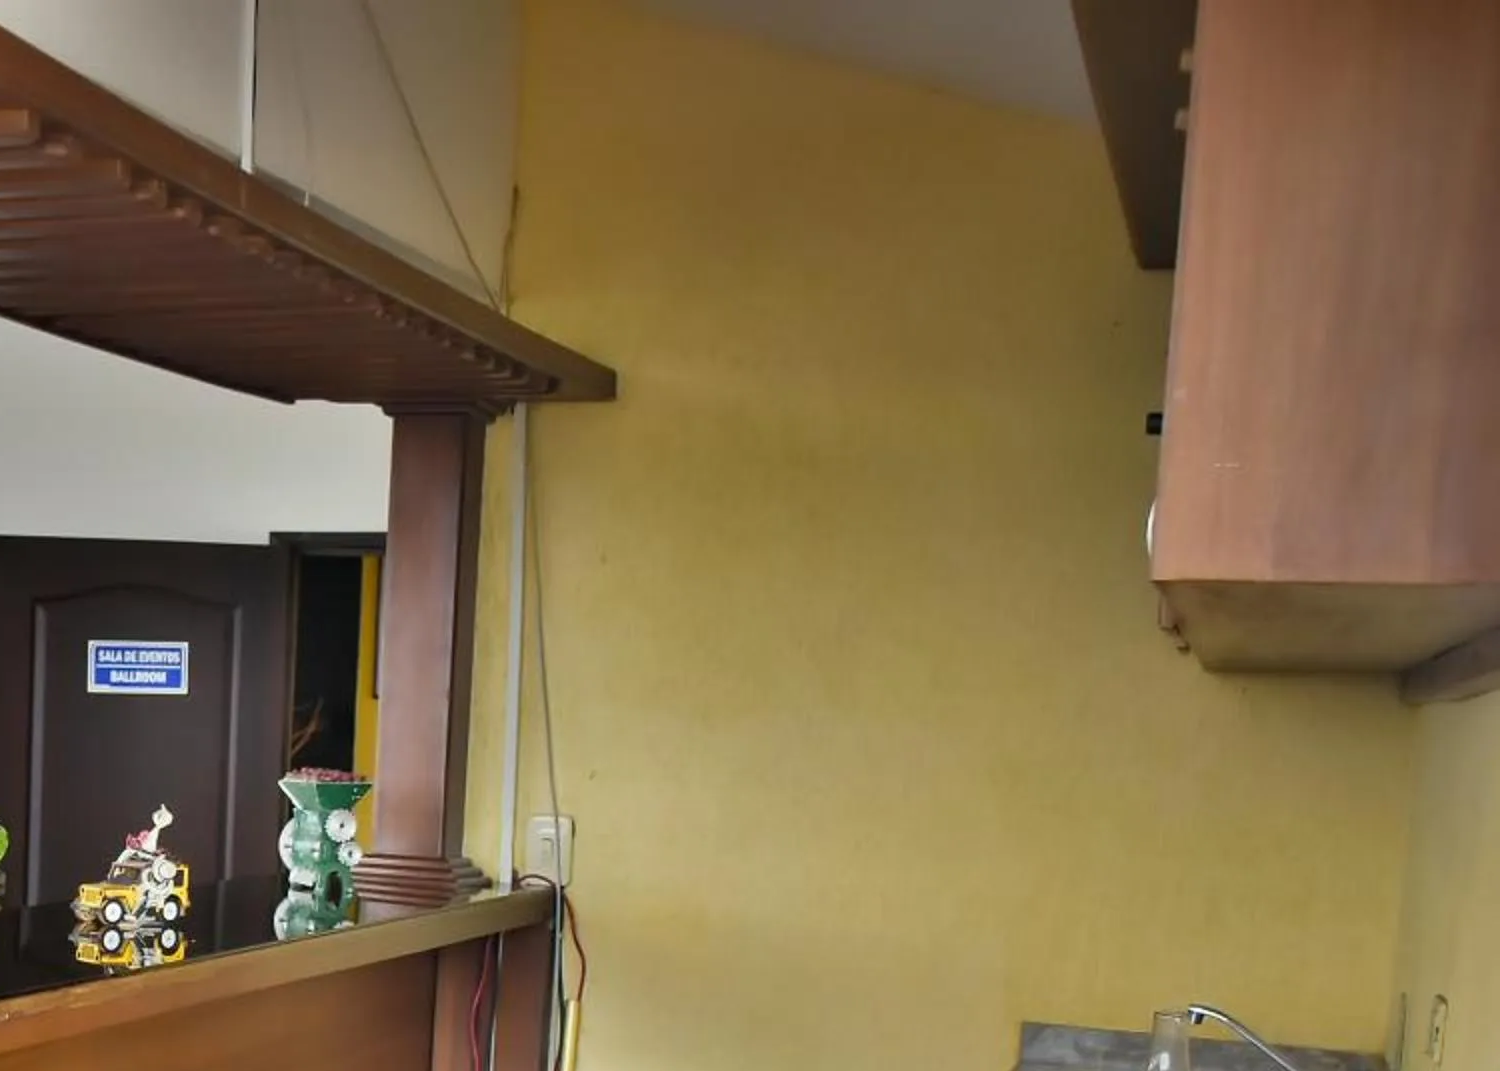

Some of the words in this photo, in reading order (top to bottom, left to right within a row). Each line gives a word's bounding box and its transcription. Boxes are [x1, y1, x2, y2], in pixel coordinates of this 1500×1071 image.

[98, 650, 122, 662] SALA
[123, 650, 137, 663] DE
[139, 651, 180, 664] EVENTOS
